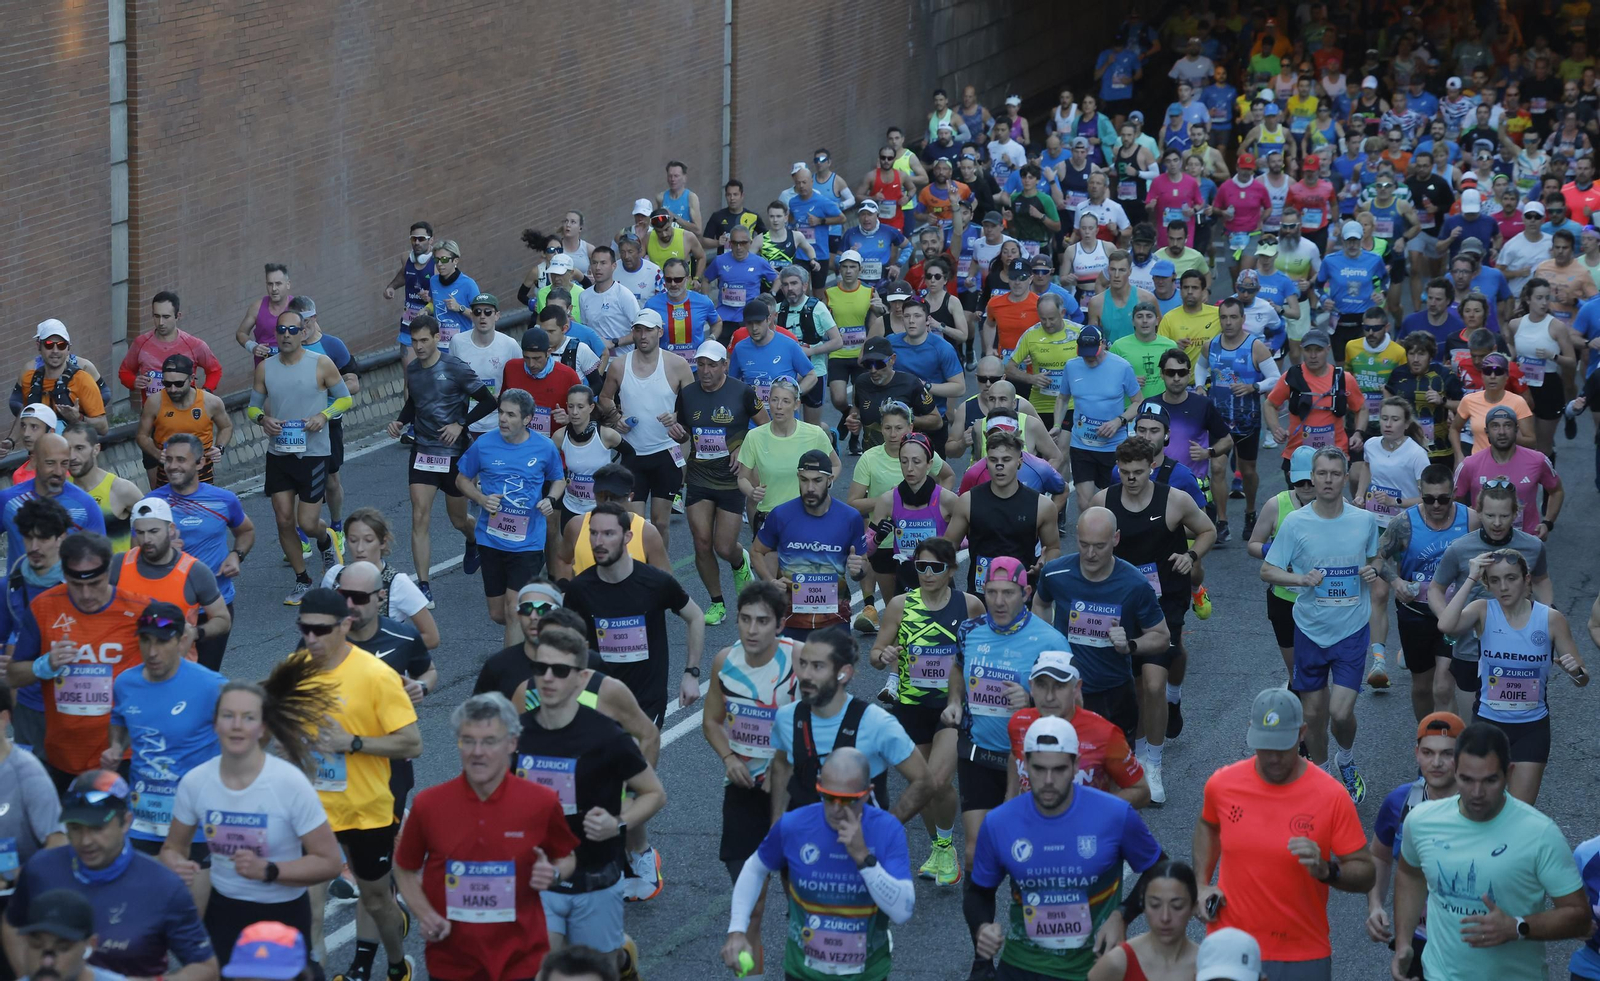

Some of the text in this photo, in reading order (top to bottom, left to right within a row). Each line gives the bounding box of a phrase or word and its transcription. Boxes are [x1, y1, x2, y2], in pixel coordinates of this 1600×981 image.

[1340, 267, 1368, 278] sljeme
[289, 437, 305, 445] LUIS
[700, 444, 720, 452] BRAVO
[426, 457, 447, 465] BENOT
[1373, 504, 1390, 513] LENA
[497, 522, 517, 533] AJRS
[786, 540, 841, 553] ASWORLD
[1417, 541, 1437, 561] SAINT
[1329, 568, 1354, 576] ZURICH
[1328, 588, 1347, 597] ERIK
[804, 595, 826, 604] JOAN
[1088, 604, 1116, 614] ZURICH
[611, 618, 639, 628] ZURICH
[1087, 618, 1103, 626] 8106
[1069, 626, 1087, 635] PEPE
[1483, 649, 1548, 663] CLAREMONT
[73, 667, 106, 675] ZURICH
[921, 668, 945, 678] VERO
[987, 670, 1015, 681] ZURICH
[986, 684, 1002, 693] 8430
[57, 691, 108, 703] JOSE LUIS
[1499, 690, 1527, 700] AOIFE
[741, 707, 772, 718] ZURICH
[740, 722, 760, 731] 10139
[732, 729, 770, 746] SAMPER
[536, 760, 569, 770] ZURICH
[146, 785, 175, 794] ZURICH
[225, 815, 261, 825] ZURICH
[467, 865, 506, 876] ZURICH
[1027, 866, 1083, 876] RUNNERS
[461, 895, 496, 907] HANS
[1044, 893, 1080, 904] ZURICH
[822, 919, 858, 931] ZURICH
[1036, 922, 1082, 935] ÁLVARO
[827, 951, 864, 963] VEZ???
